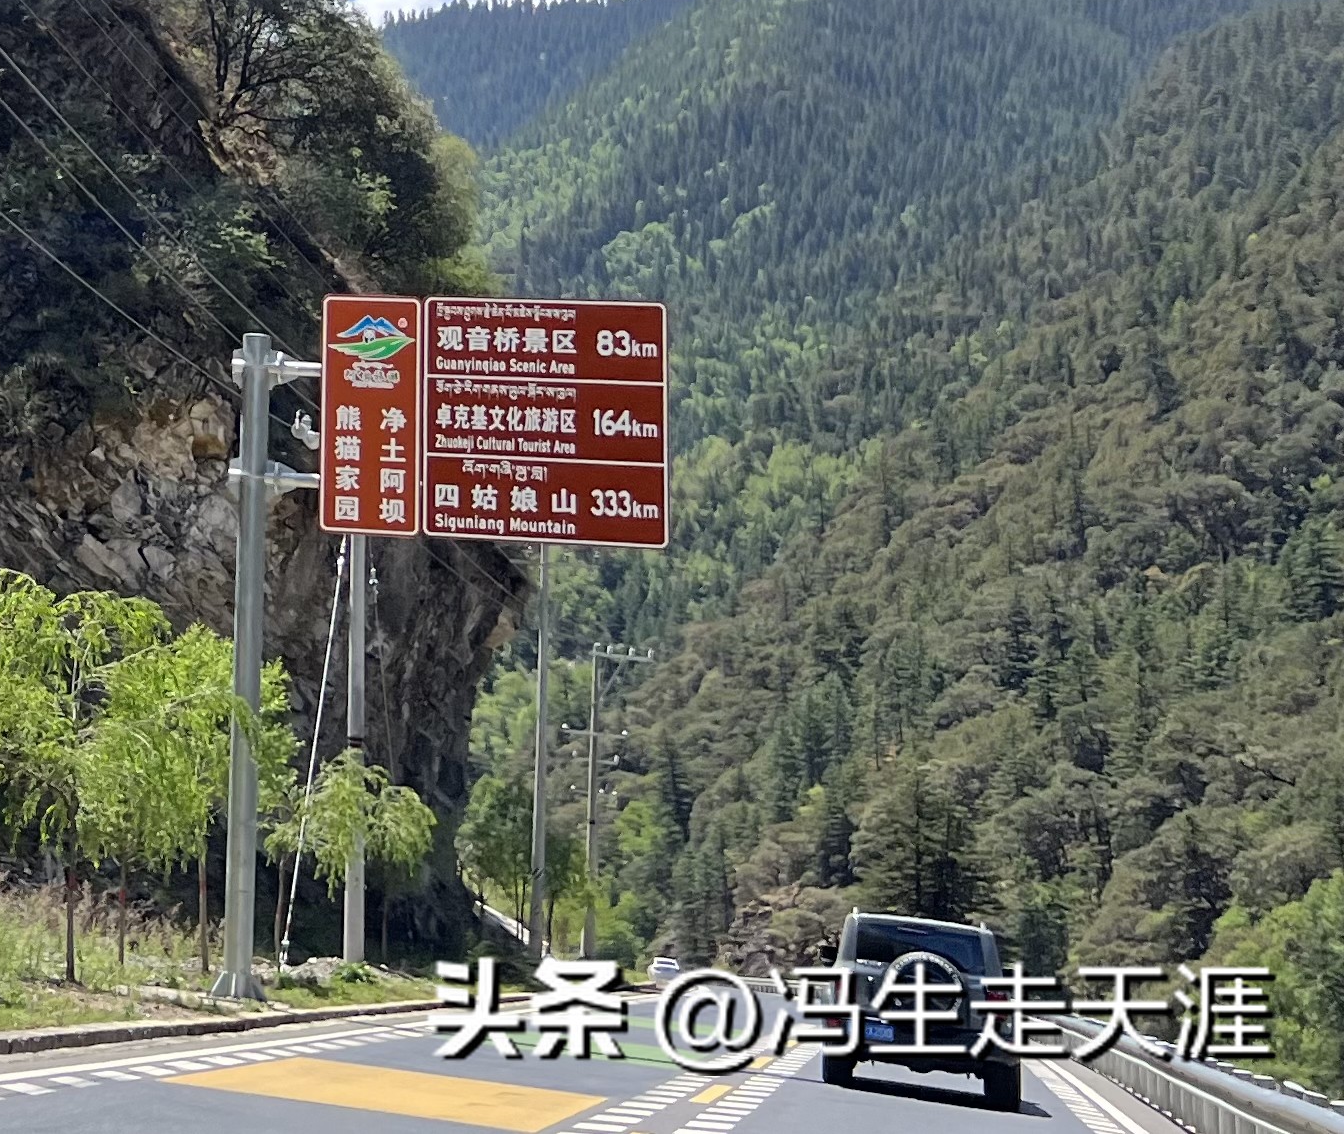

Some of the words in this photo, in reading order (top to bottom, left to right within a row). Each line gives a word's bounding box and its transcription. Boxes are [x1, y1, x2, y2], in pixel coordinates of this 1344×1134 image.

[436, 325, 577, 354] 观音桥景区
[435, 355, 506, 374] Guanyinqiao
[509, 358, 547, 373] Scenic
[549, 360, 575, 375] Area
[435, 403, 577, 433] 卓克基文化旅游区
[435, 433, 474, 453] Zhuokeji
[476, 435, 515, 451] Cultural
[517, 437, 551, 453] Tourist
[553, 439, 576, 454] Area
[334, 404, 362, 522] 熊猫家园
[379, 406, 407, 524] 净土阿坝
[434, 483, 577, 515] 四姑娘山
[434, 513, 504, 534] Siguniang
[509, 517, 576, 535] Mountain
